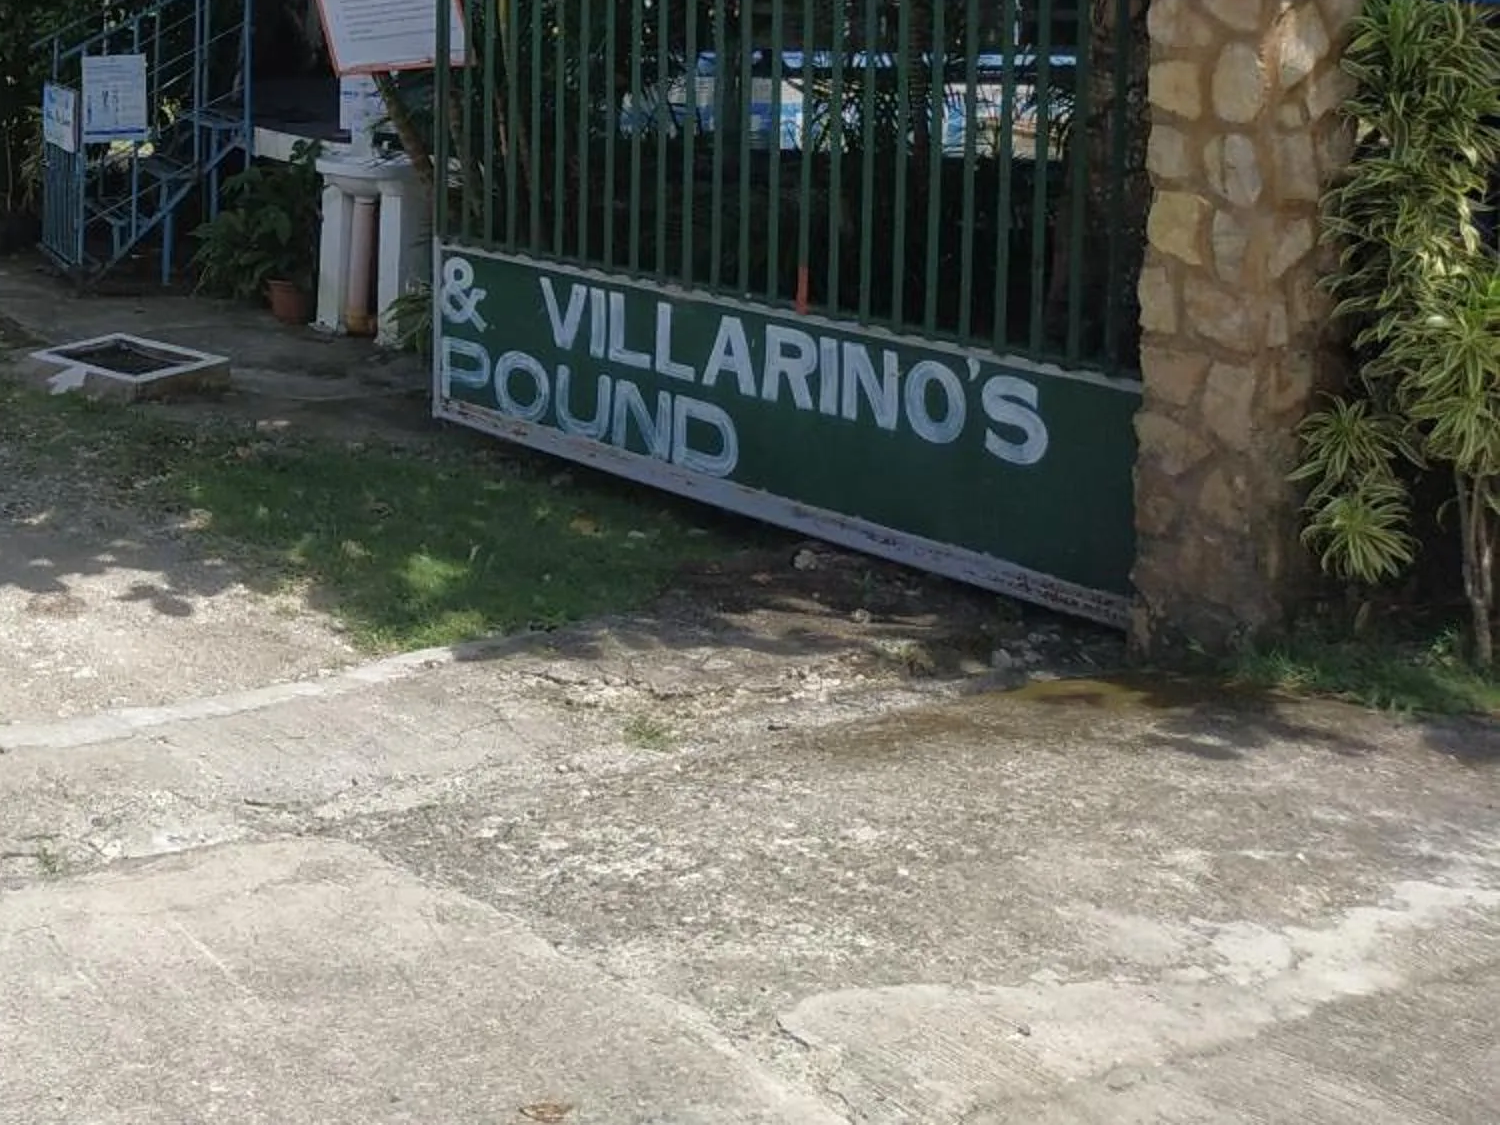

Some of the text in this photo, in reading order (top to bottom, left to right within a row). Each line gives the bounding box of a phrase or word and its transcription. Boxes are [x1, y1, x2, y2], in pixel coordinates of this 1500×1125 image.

[440, 335, 739, 477] POUND
[441, 255, 1049, 465] & VILLARINO'S
